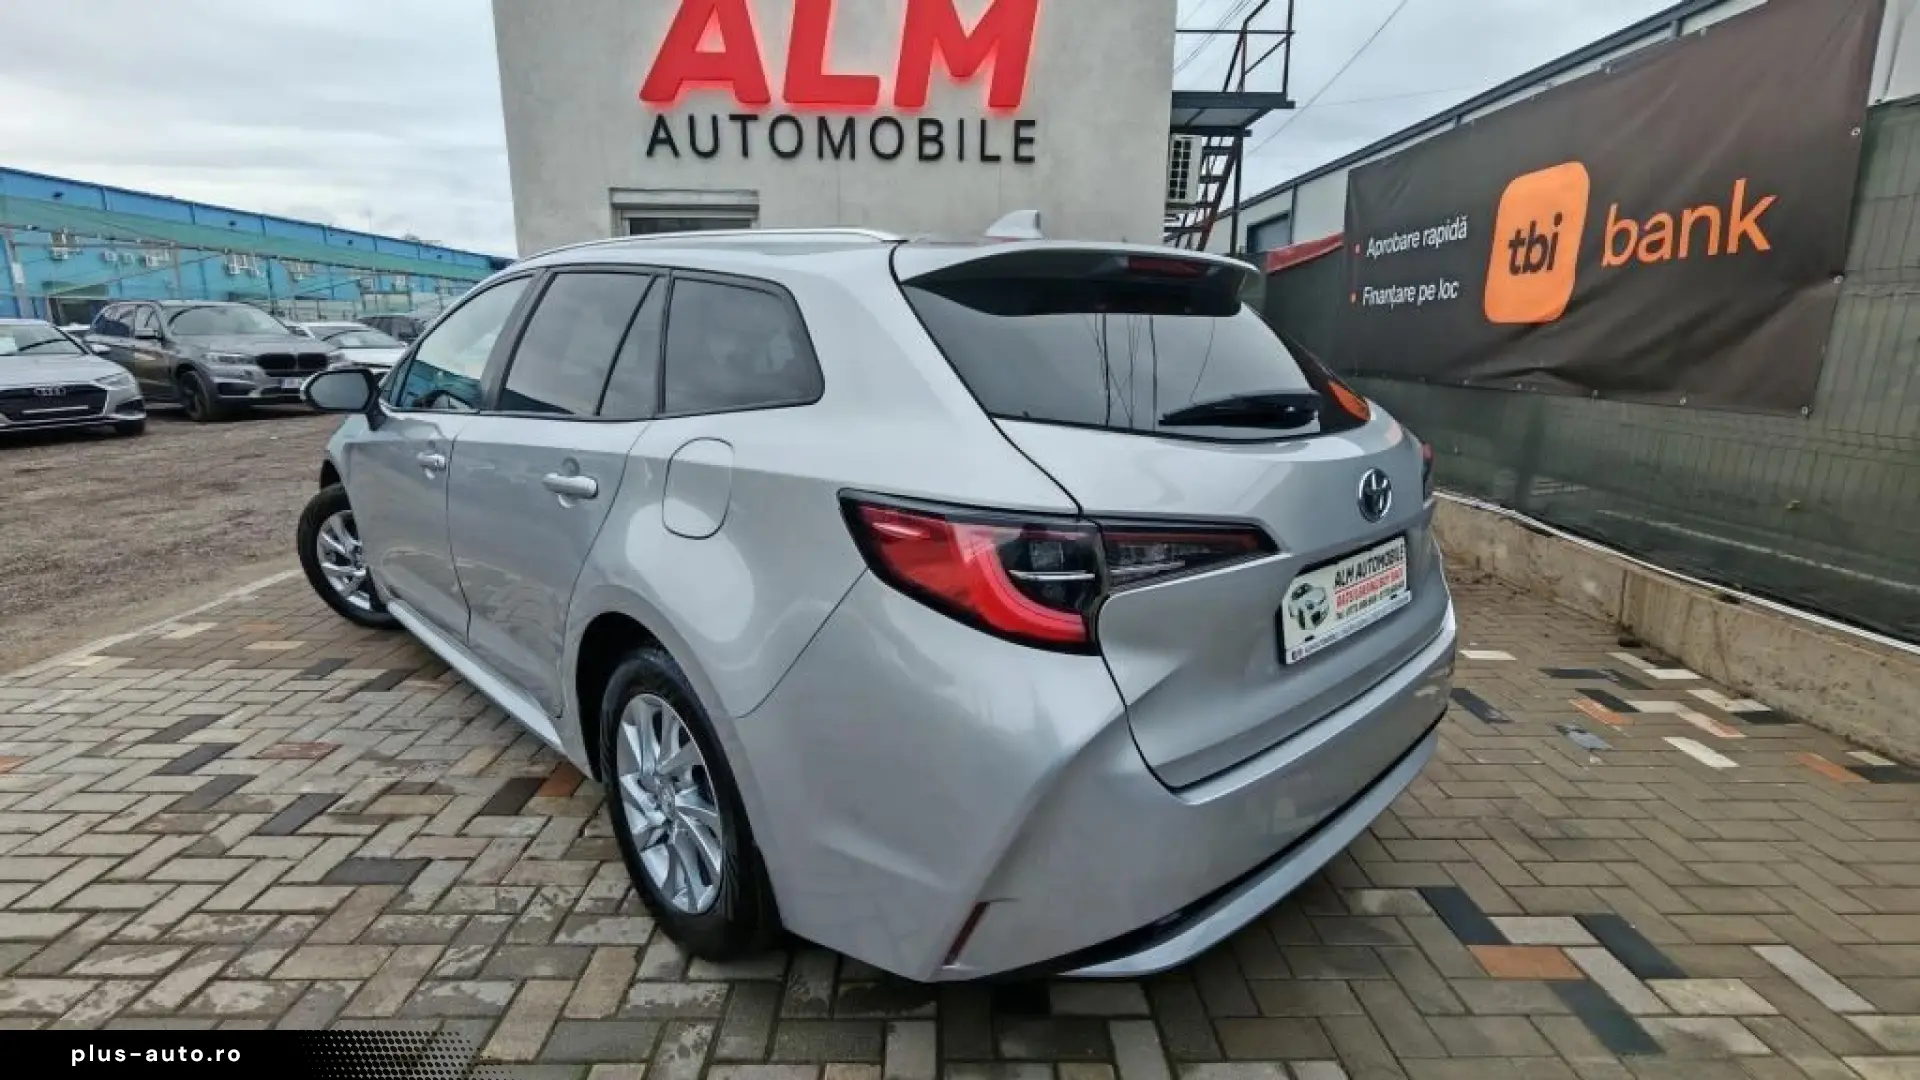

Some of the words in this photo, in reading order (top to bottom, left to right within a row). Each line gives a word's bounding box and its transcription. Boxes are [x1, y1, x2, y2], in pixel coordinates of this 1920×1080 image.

[640, 0, 1040, 107] ALM
[646, 113, 1036, 163] AUTOMOBILE
[1366, 231, 1420, 259] Aprobare
[1422, 214, 1468, 249] rapidă
[1507, 212, 1563, 276] tbi
[1602, 178, 1777, 268] bank
[1417, 283, 1436, 306] pe
[1438, 277, 1460, 300] loc
